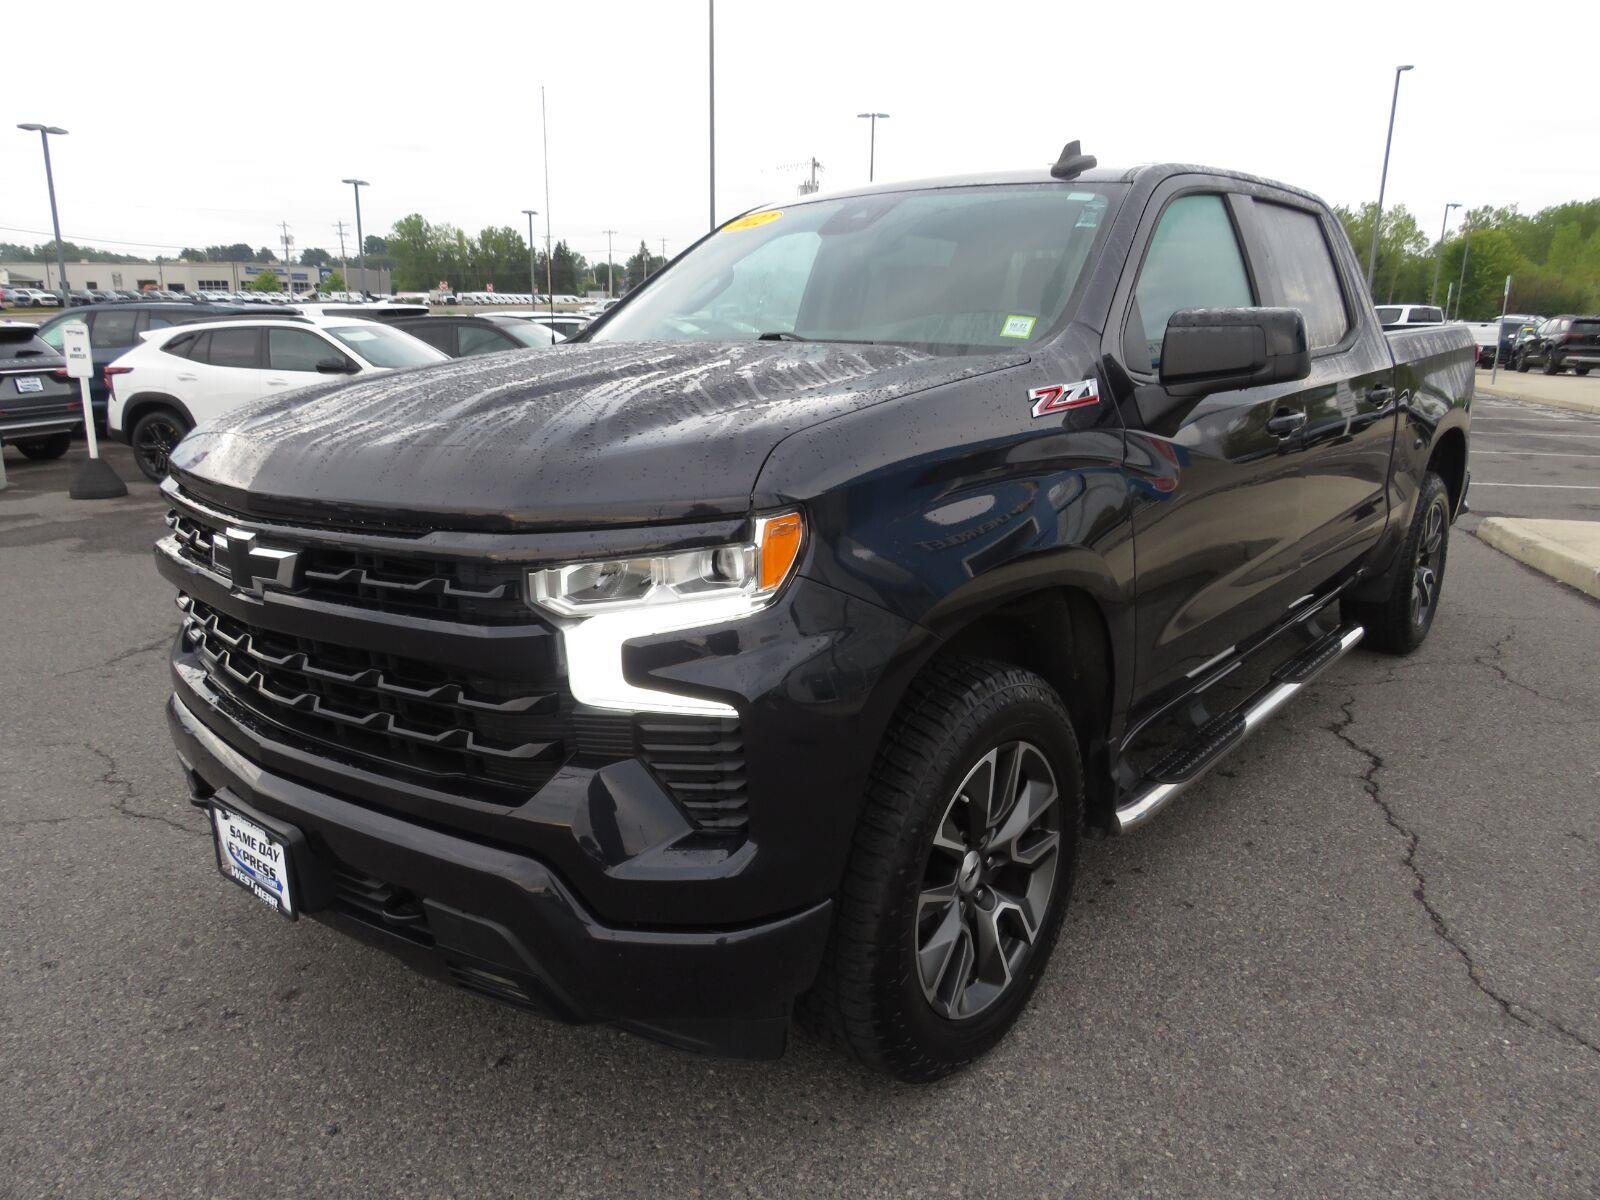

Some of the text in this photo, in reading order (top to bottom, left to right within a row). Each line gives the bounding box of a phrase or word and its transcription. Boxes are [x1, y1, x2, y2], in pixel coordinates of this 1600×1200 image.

[1029, 378, 1100, 418] Z71
[228, 841, 277, 880] EXPRESS
[229, 825, 281, 862] SAME DAY
[231, 865, 256, 889] WEST
[254, 885, 279, 909] HERR
